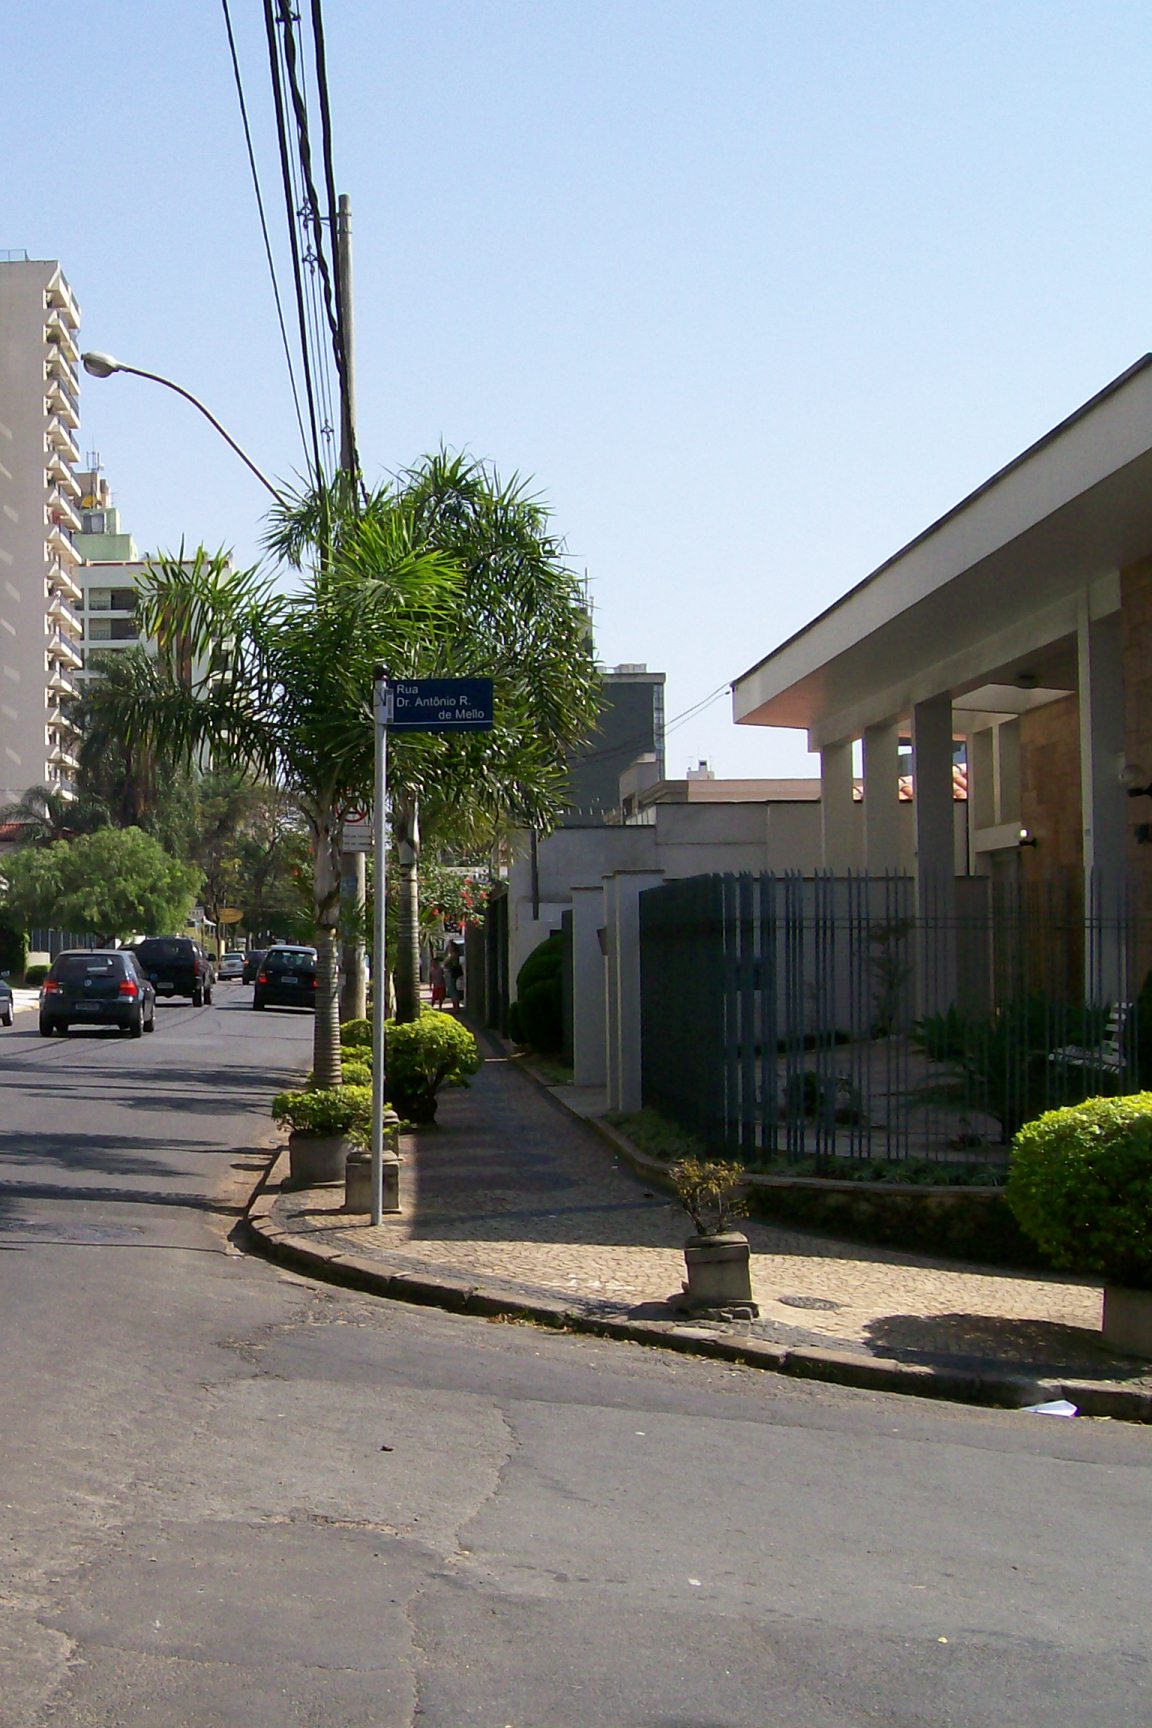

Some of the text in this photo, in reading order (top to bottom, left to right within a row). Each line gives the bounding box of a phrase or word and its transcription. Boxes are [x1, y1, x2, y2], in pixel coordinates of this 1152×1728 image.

[396, 684, 419, 694] Rua
[396, 695, 472, 708] Dr. Antônio R.
[438, 708, 485, 720] de Mello
